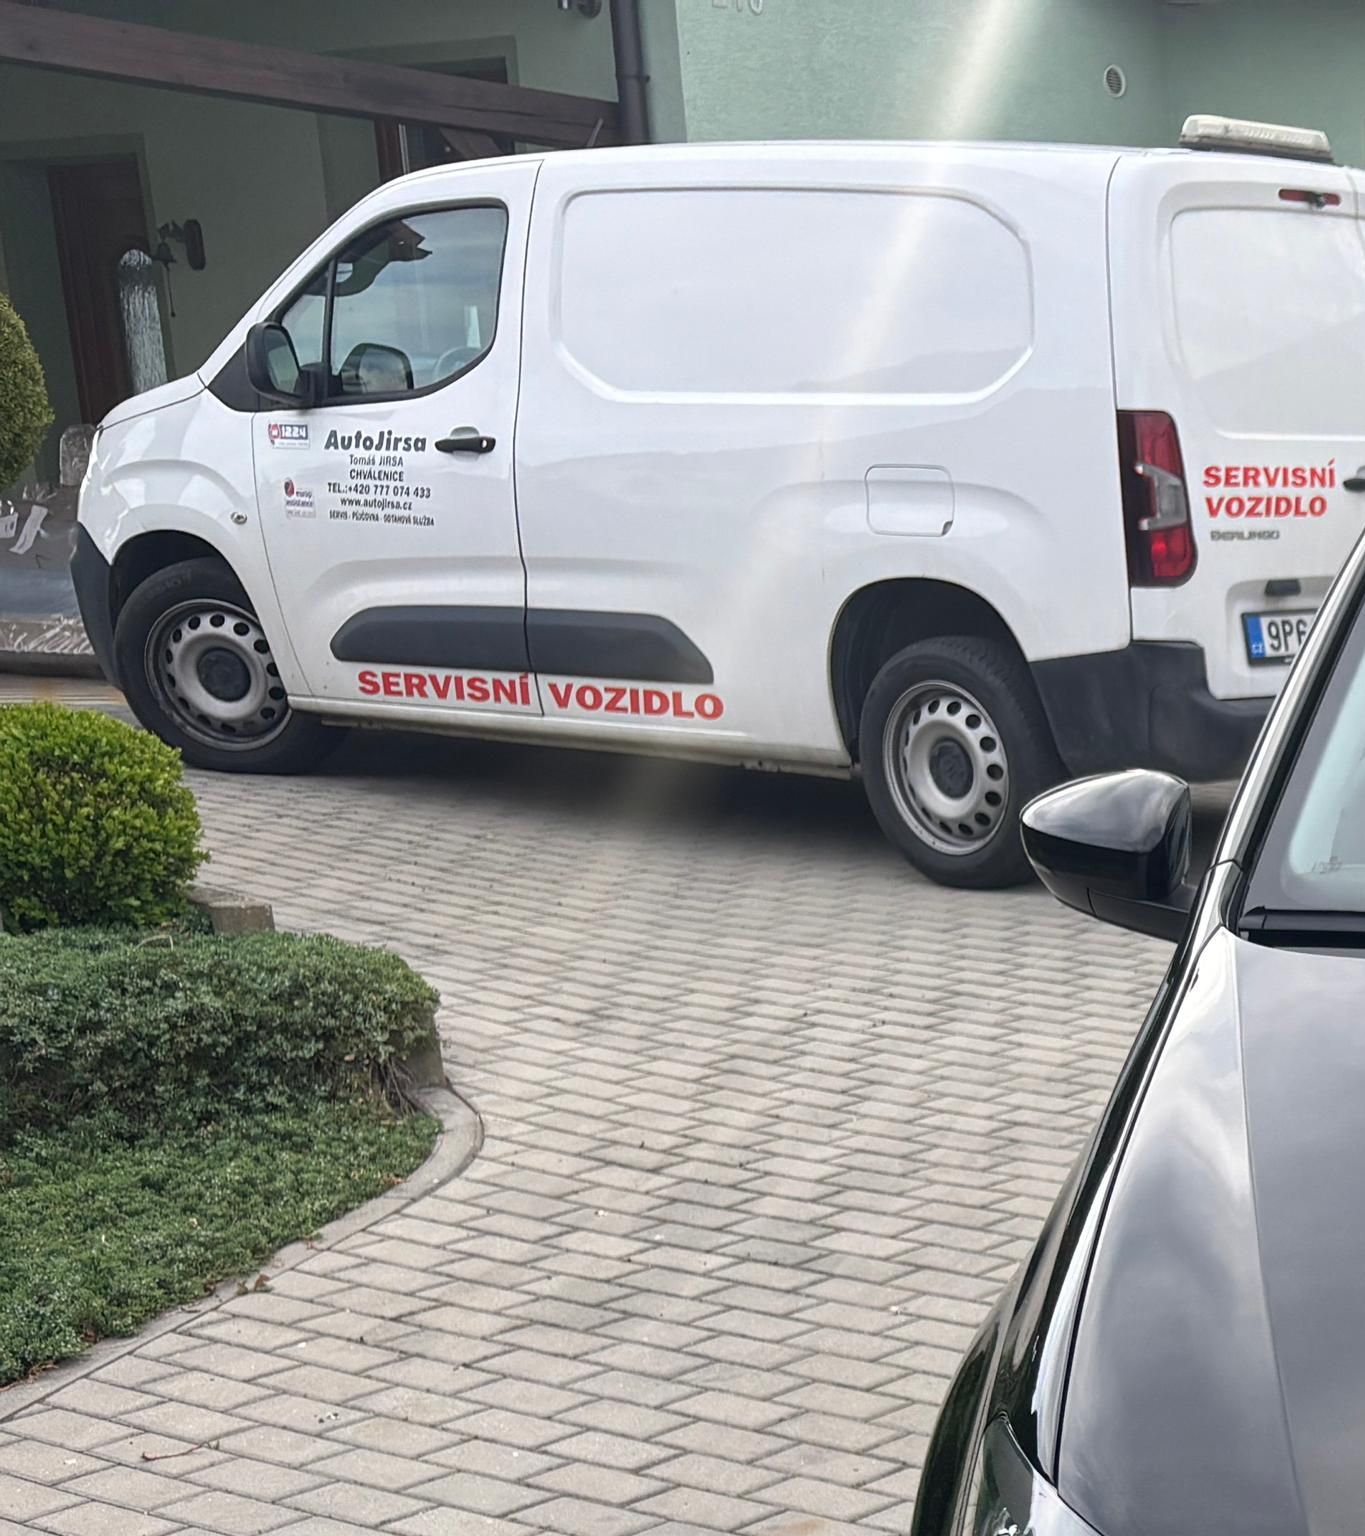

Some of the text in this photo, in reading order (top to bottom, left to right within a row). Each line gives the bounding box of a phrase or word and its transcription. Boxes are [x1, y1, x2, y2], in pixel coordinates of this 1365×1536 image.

[324, 429, 427, 452] AutoJirsa
[379, 455, 403, 467] JIRSA
[349, 467, 404, 482] CHVÁLENICE
[1203, 458, 1336, 488] SERVISNÍ
[373, 484, 390, 496] 777
[392, 485, 410, 497] 074
[413, 486, 431, 499] 433
[340, 497, 412, 511] www.autojirsa.cz
[1205, 495, 1328, 518] VOZIDLO
[357, 670, 724, 720] SERVISNÍ VOZIDLO
